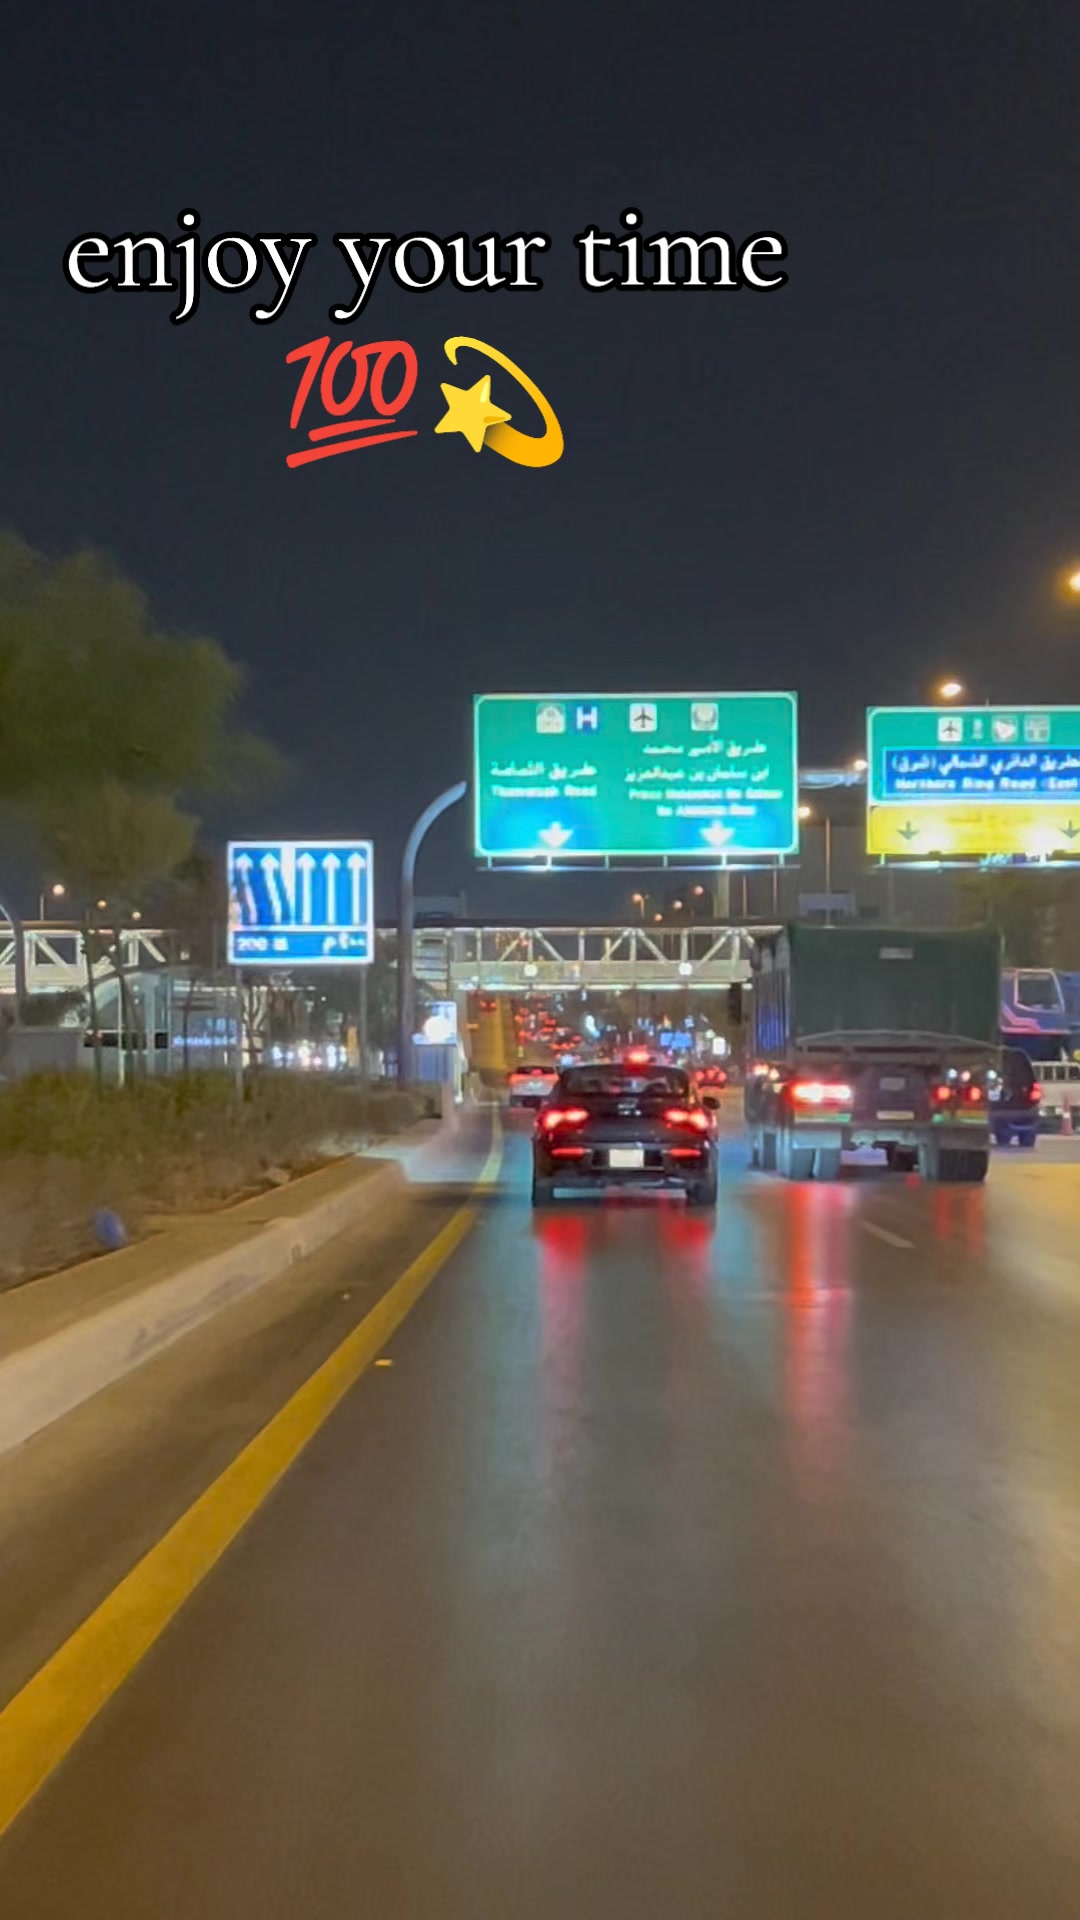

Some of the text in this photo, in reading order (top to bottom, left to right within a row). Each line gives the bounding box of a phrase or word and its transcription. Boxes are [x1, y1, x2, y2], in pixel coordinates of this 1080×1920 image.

[727, 739, 767, 758] طريق
[548, 760, 597, 780] طريق
[1000, 777, 1036, 790] Road
